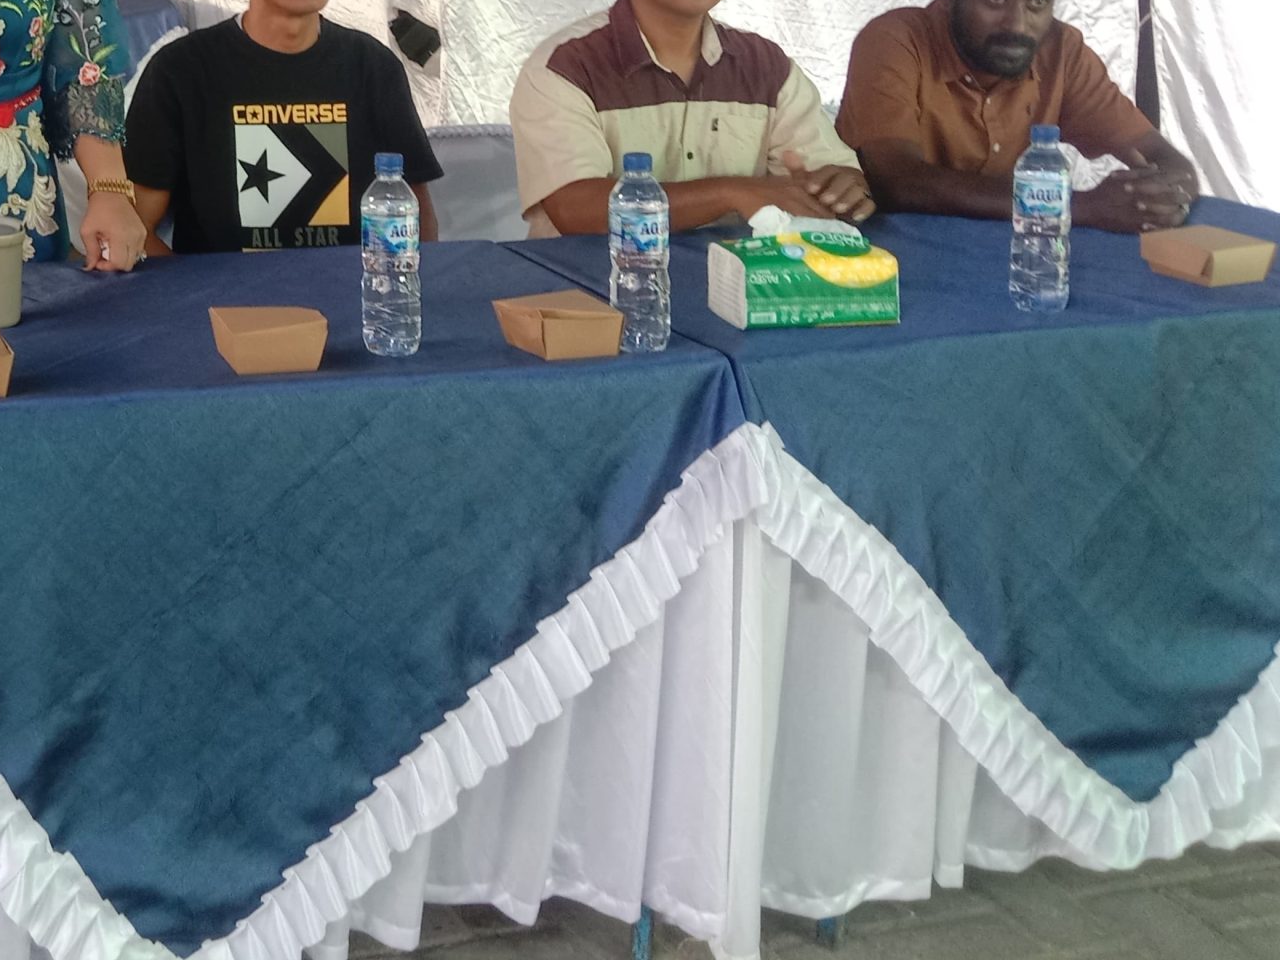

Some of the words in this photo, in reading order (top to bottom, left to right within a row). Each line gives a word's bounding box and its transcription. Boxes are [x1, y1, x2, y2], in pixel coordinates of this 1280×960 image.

[232, 103, 348, 124] CONVERSE
[1026, 188, 1063, 203] AQUA
[252, 227, 283, 247] ALL
[295, 226, 340, 246] STAR
